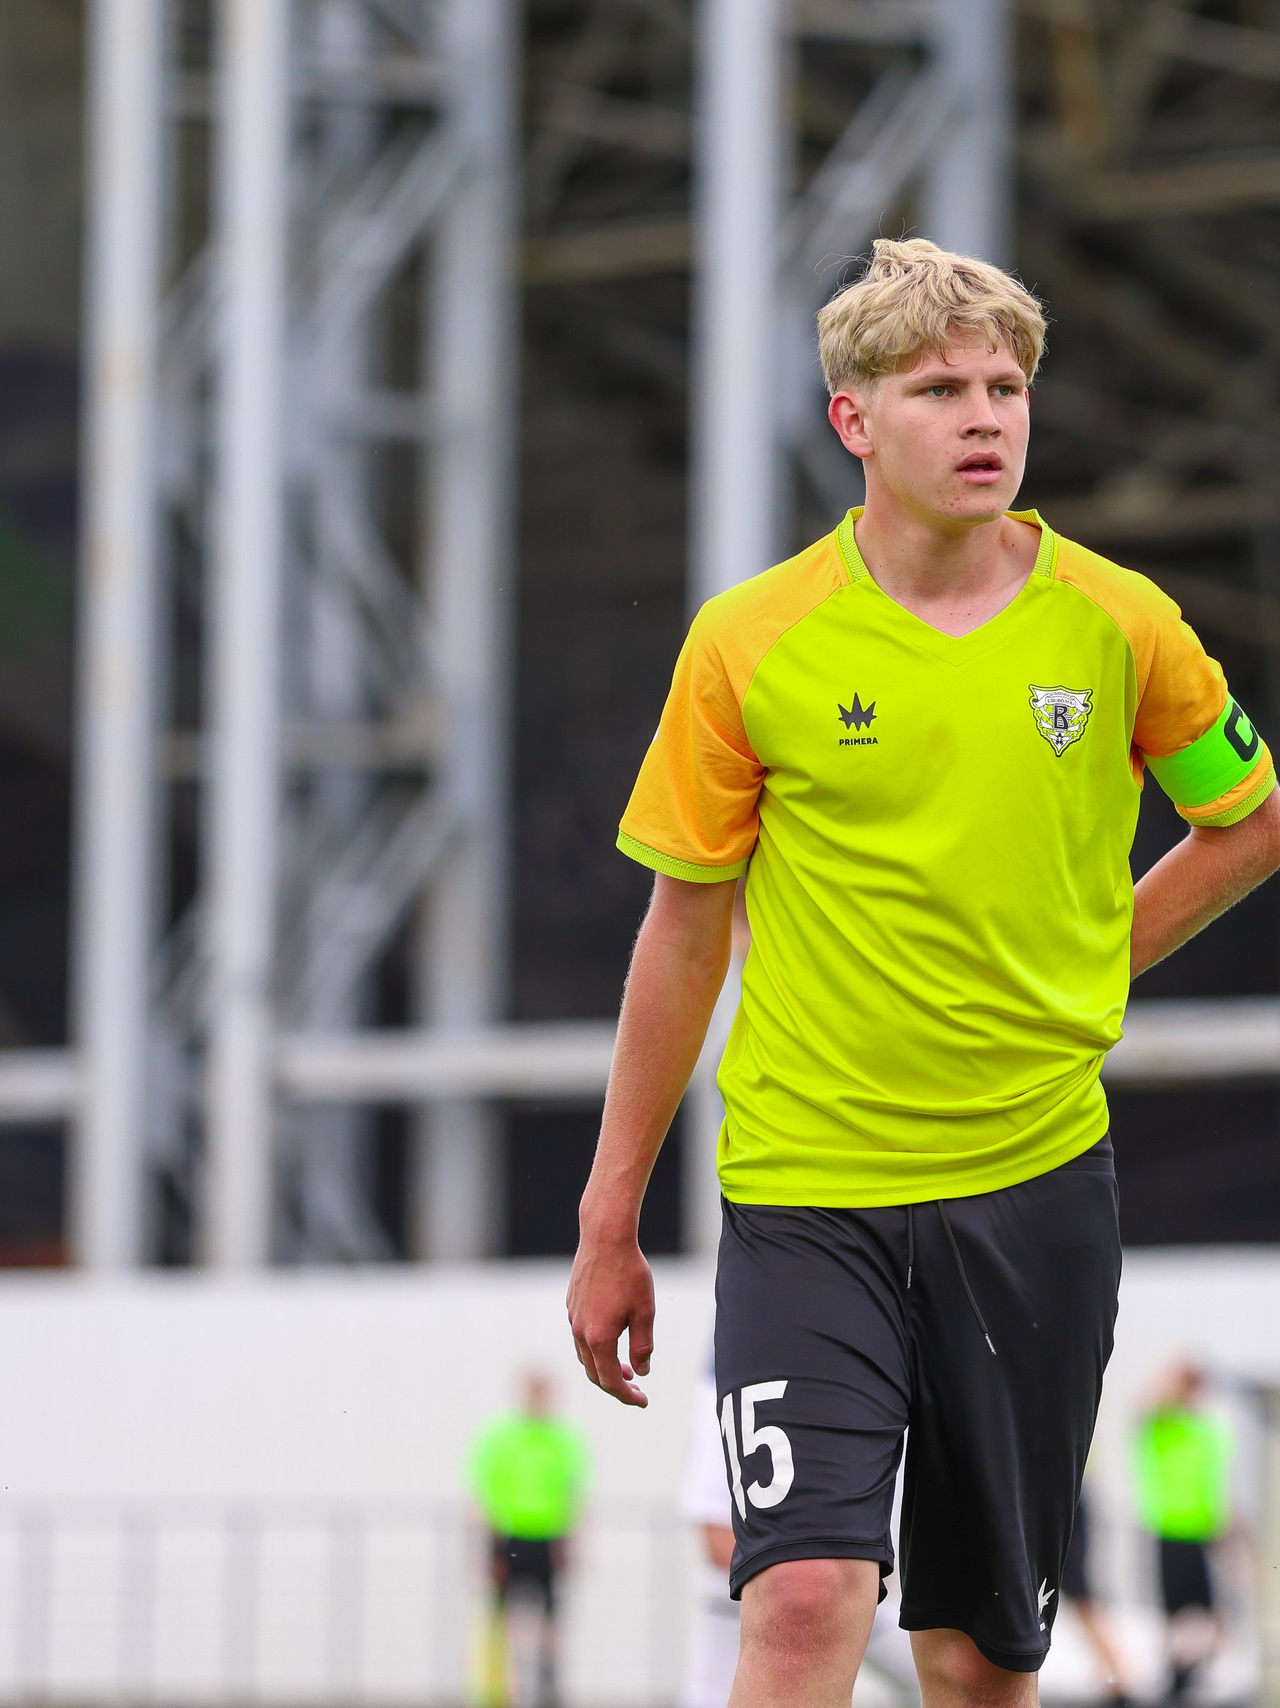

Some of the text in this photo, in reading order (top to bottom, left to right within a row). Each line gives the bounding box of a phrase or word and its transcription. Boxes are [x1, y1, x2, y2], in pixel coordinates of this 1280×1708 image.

[839, 737, 878, 746] PRIMERA
[1223, 701, 1259, 763] C
[721, 1380, 795, 1522] 15
